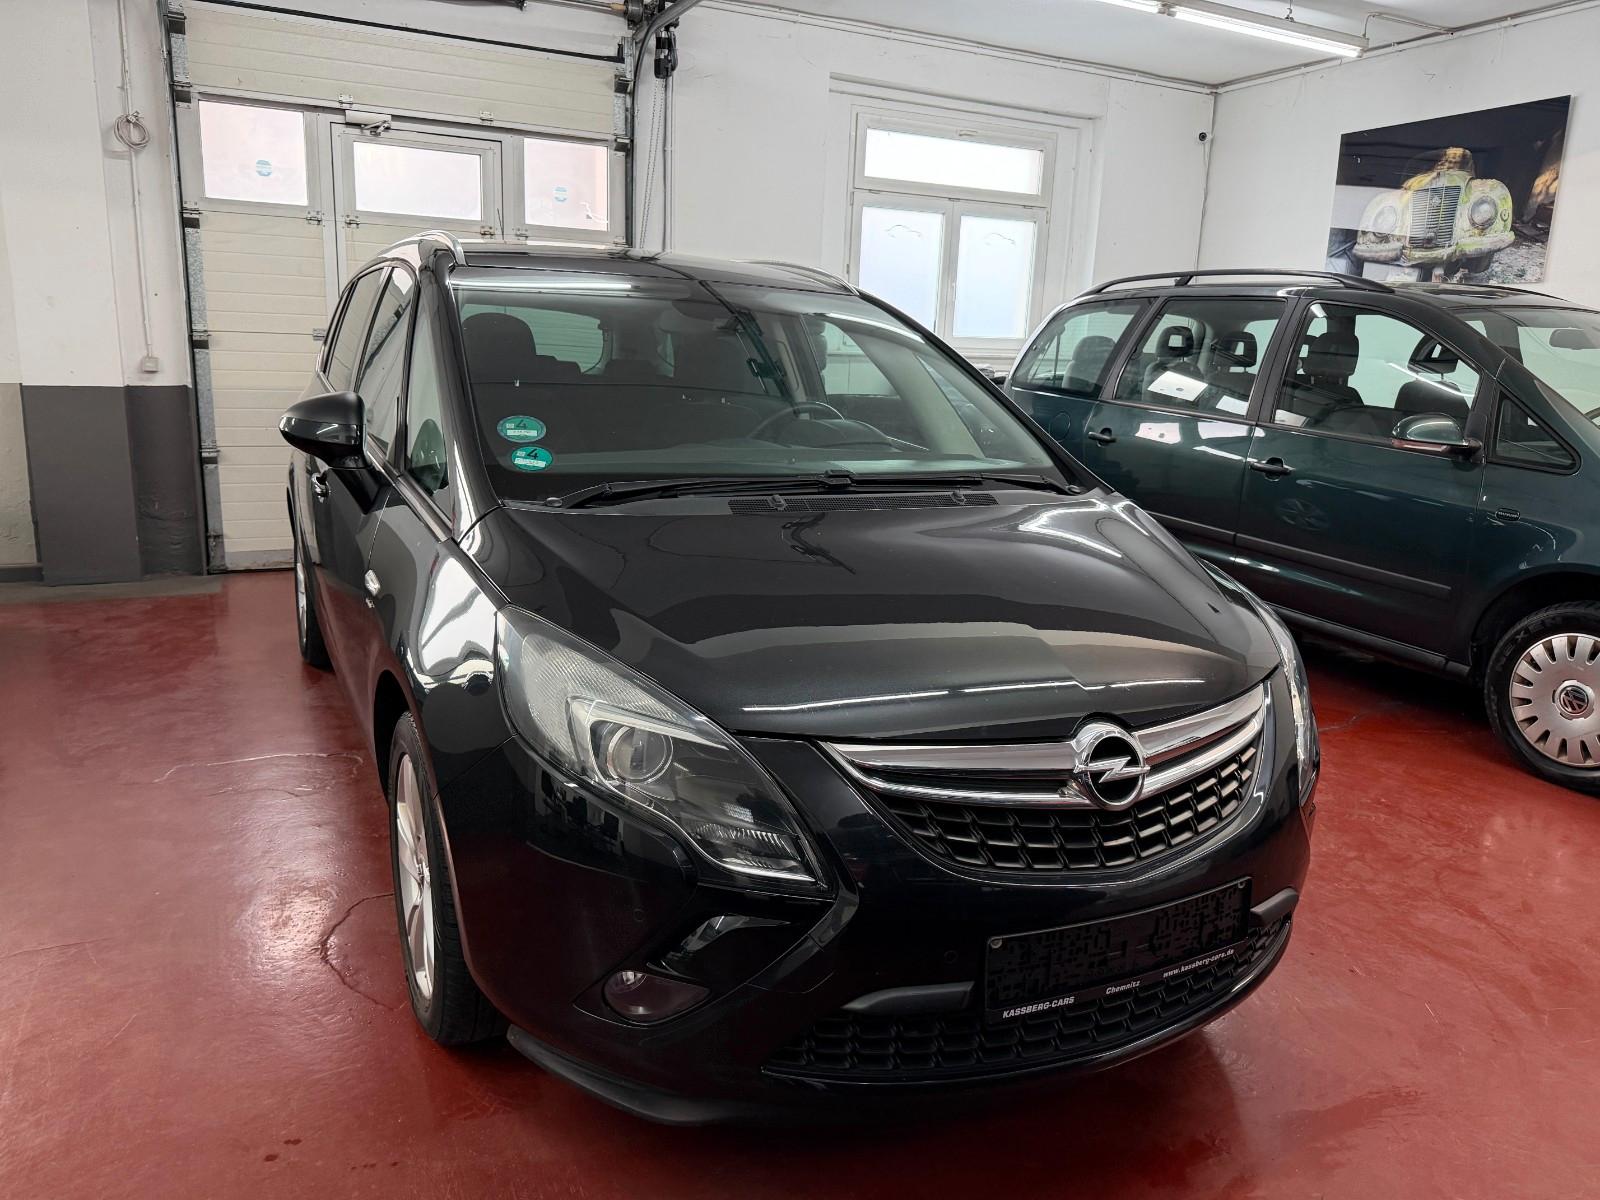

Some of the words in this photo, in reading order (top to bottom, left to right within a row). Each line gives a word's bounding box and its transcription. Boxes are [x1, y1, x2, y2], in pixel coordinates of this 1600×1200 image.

[527, 448, 539, 460] 4
[1002, 995, 1075, 1019] KASSBERG-CARS
[1105, 980, 1141, 995] Chemnitz
[1162, 948, 1235, 979] www.kassberg-cars.de
